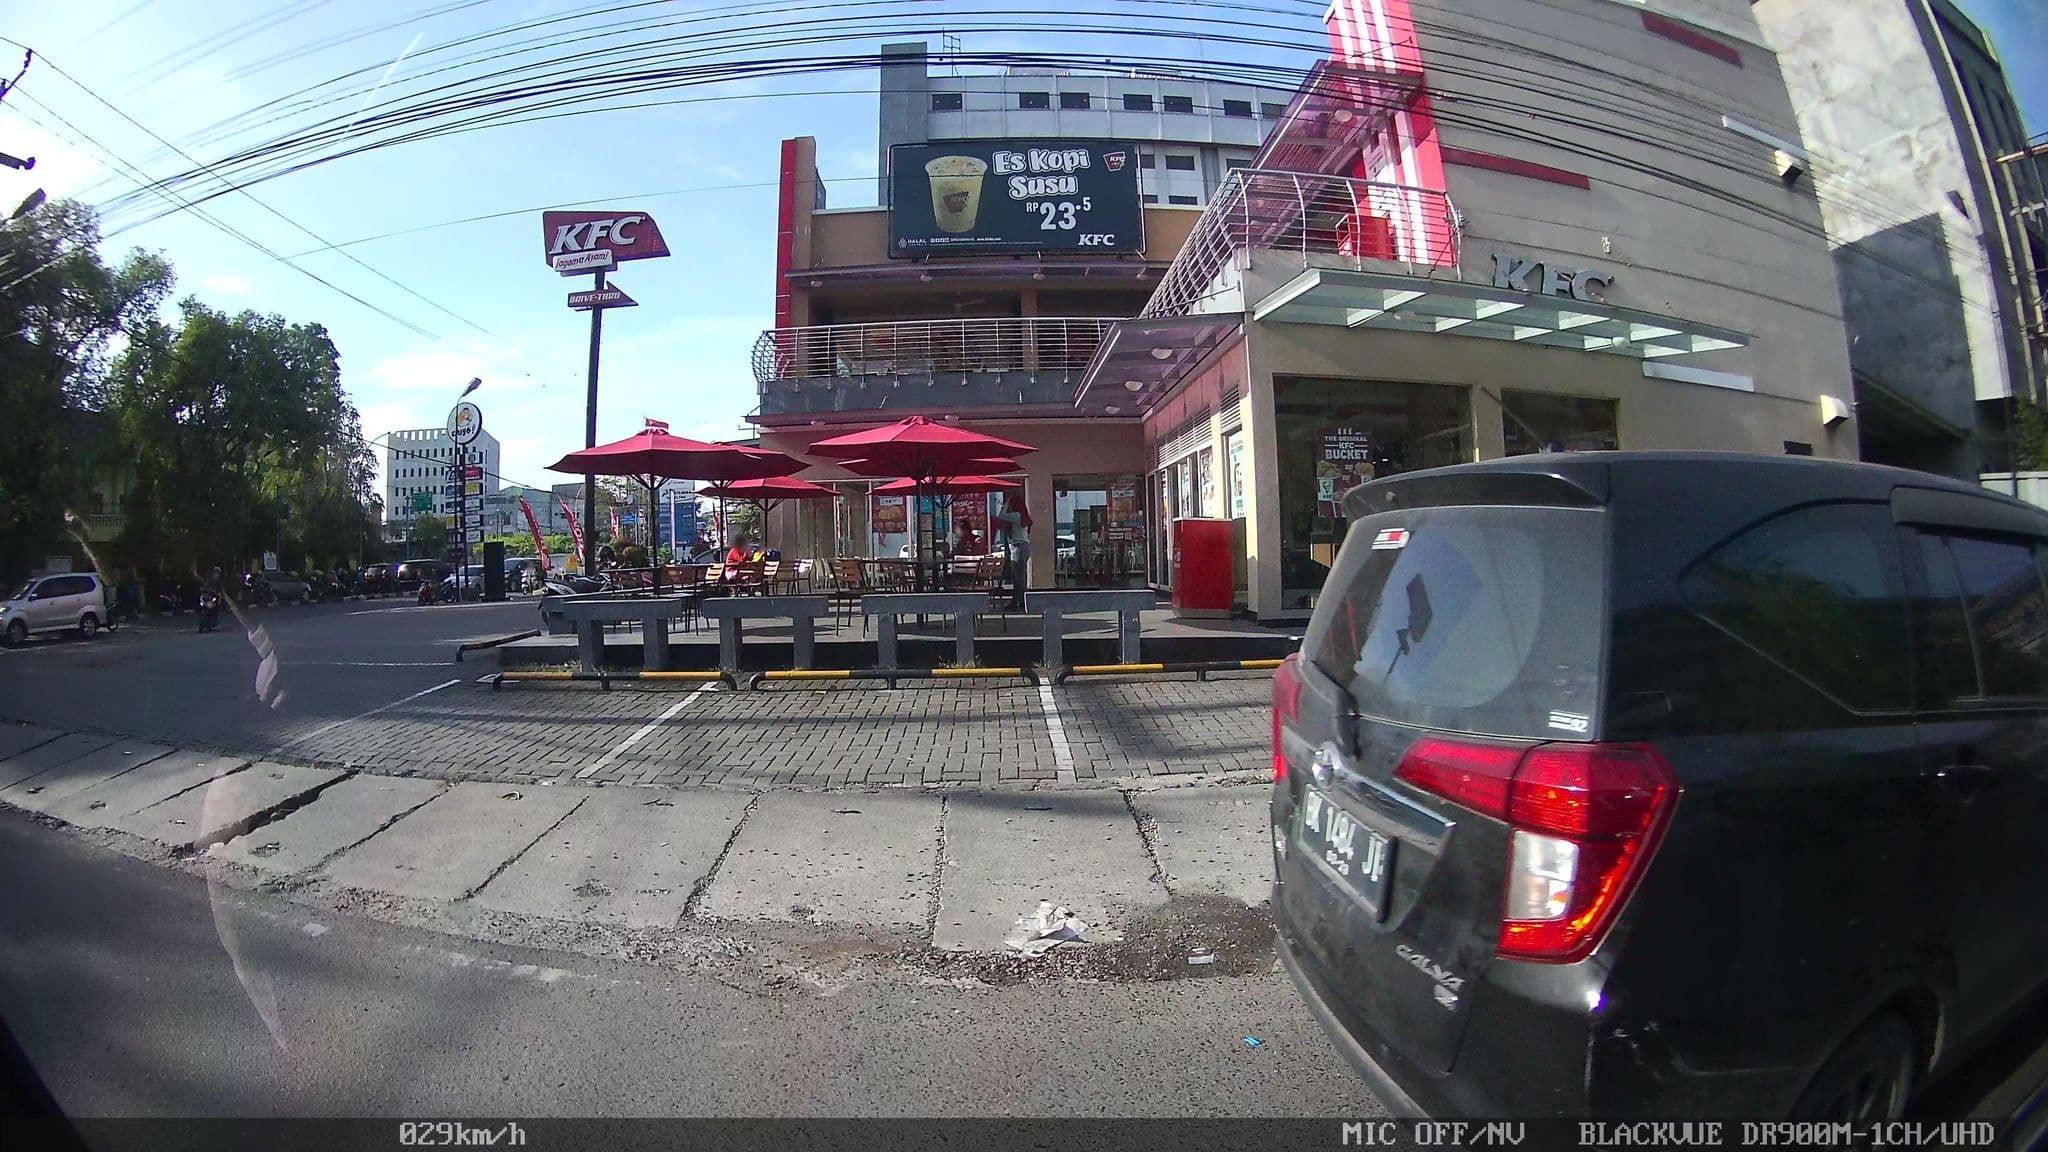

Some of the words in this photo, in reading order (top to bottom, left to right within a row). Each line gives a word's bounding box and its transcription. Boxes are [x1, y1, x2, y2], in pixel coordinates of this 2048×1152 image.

[994, 152, 1026, 173] Es
[1029, 149, 1089, 172] Kopi
[1009, 175, 1077, 199] Susu
[549, 216, 643, 255] KFC
[1078, 234, 1115, 246] KFC
[1491, 252, 1615, 301] KFC
[1325, 449, 1368, 460] BUCKET
